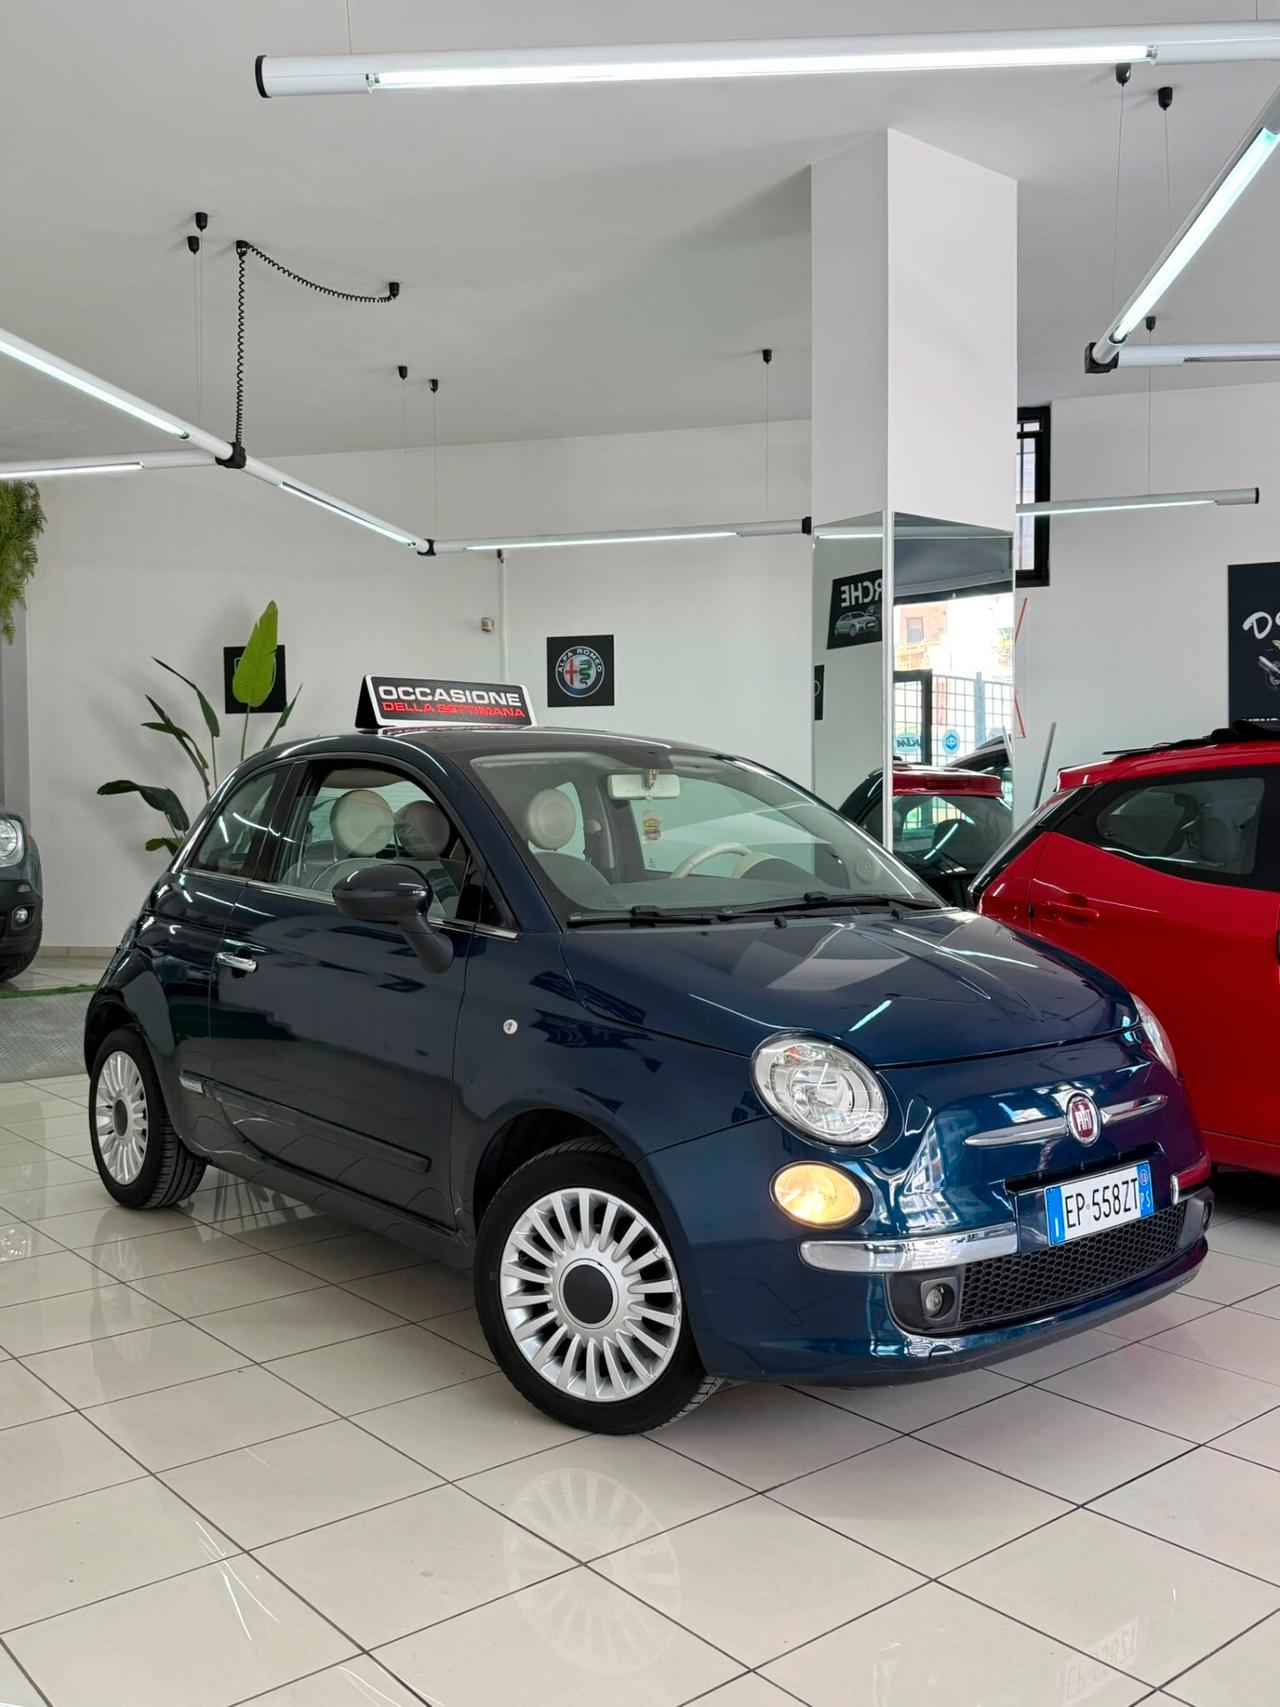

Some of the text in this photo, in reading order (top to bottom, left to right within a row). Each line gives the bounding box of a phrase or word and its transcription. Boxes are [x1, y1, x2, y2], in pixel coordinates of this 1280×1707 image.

[558, 648, 602, 673] ALFA ROMEO
[378, 686, 522, 706] OCCASIONE
[383, 701, 434, 713] DELLA
[1075, 1109, 1092, 1132] FIAT
